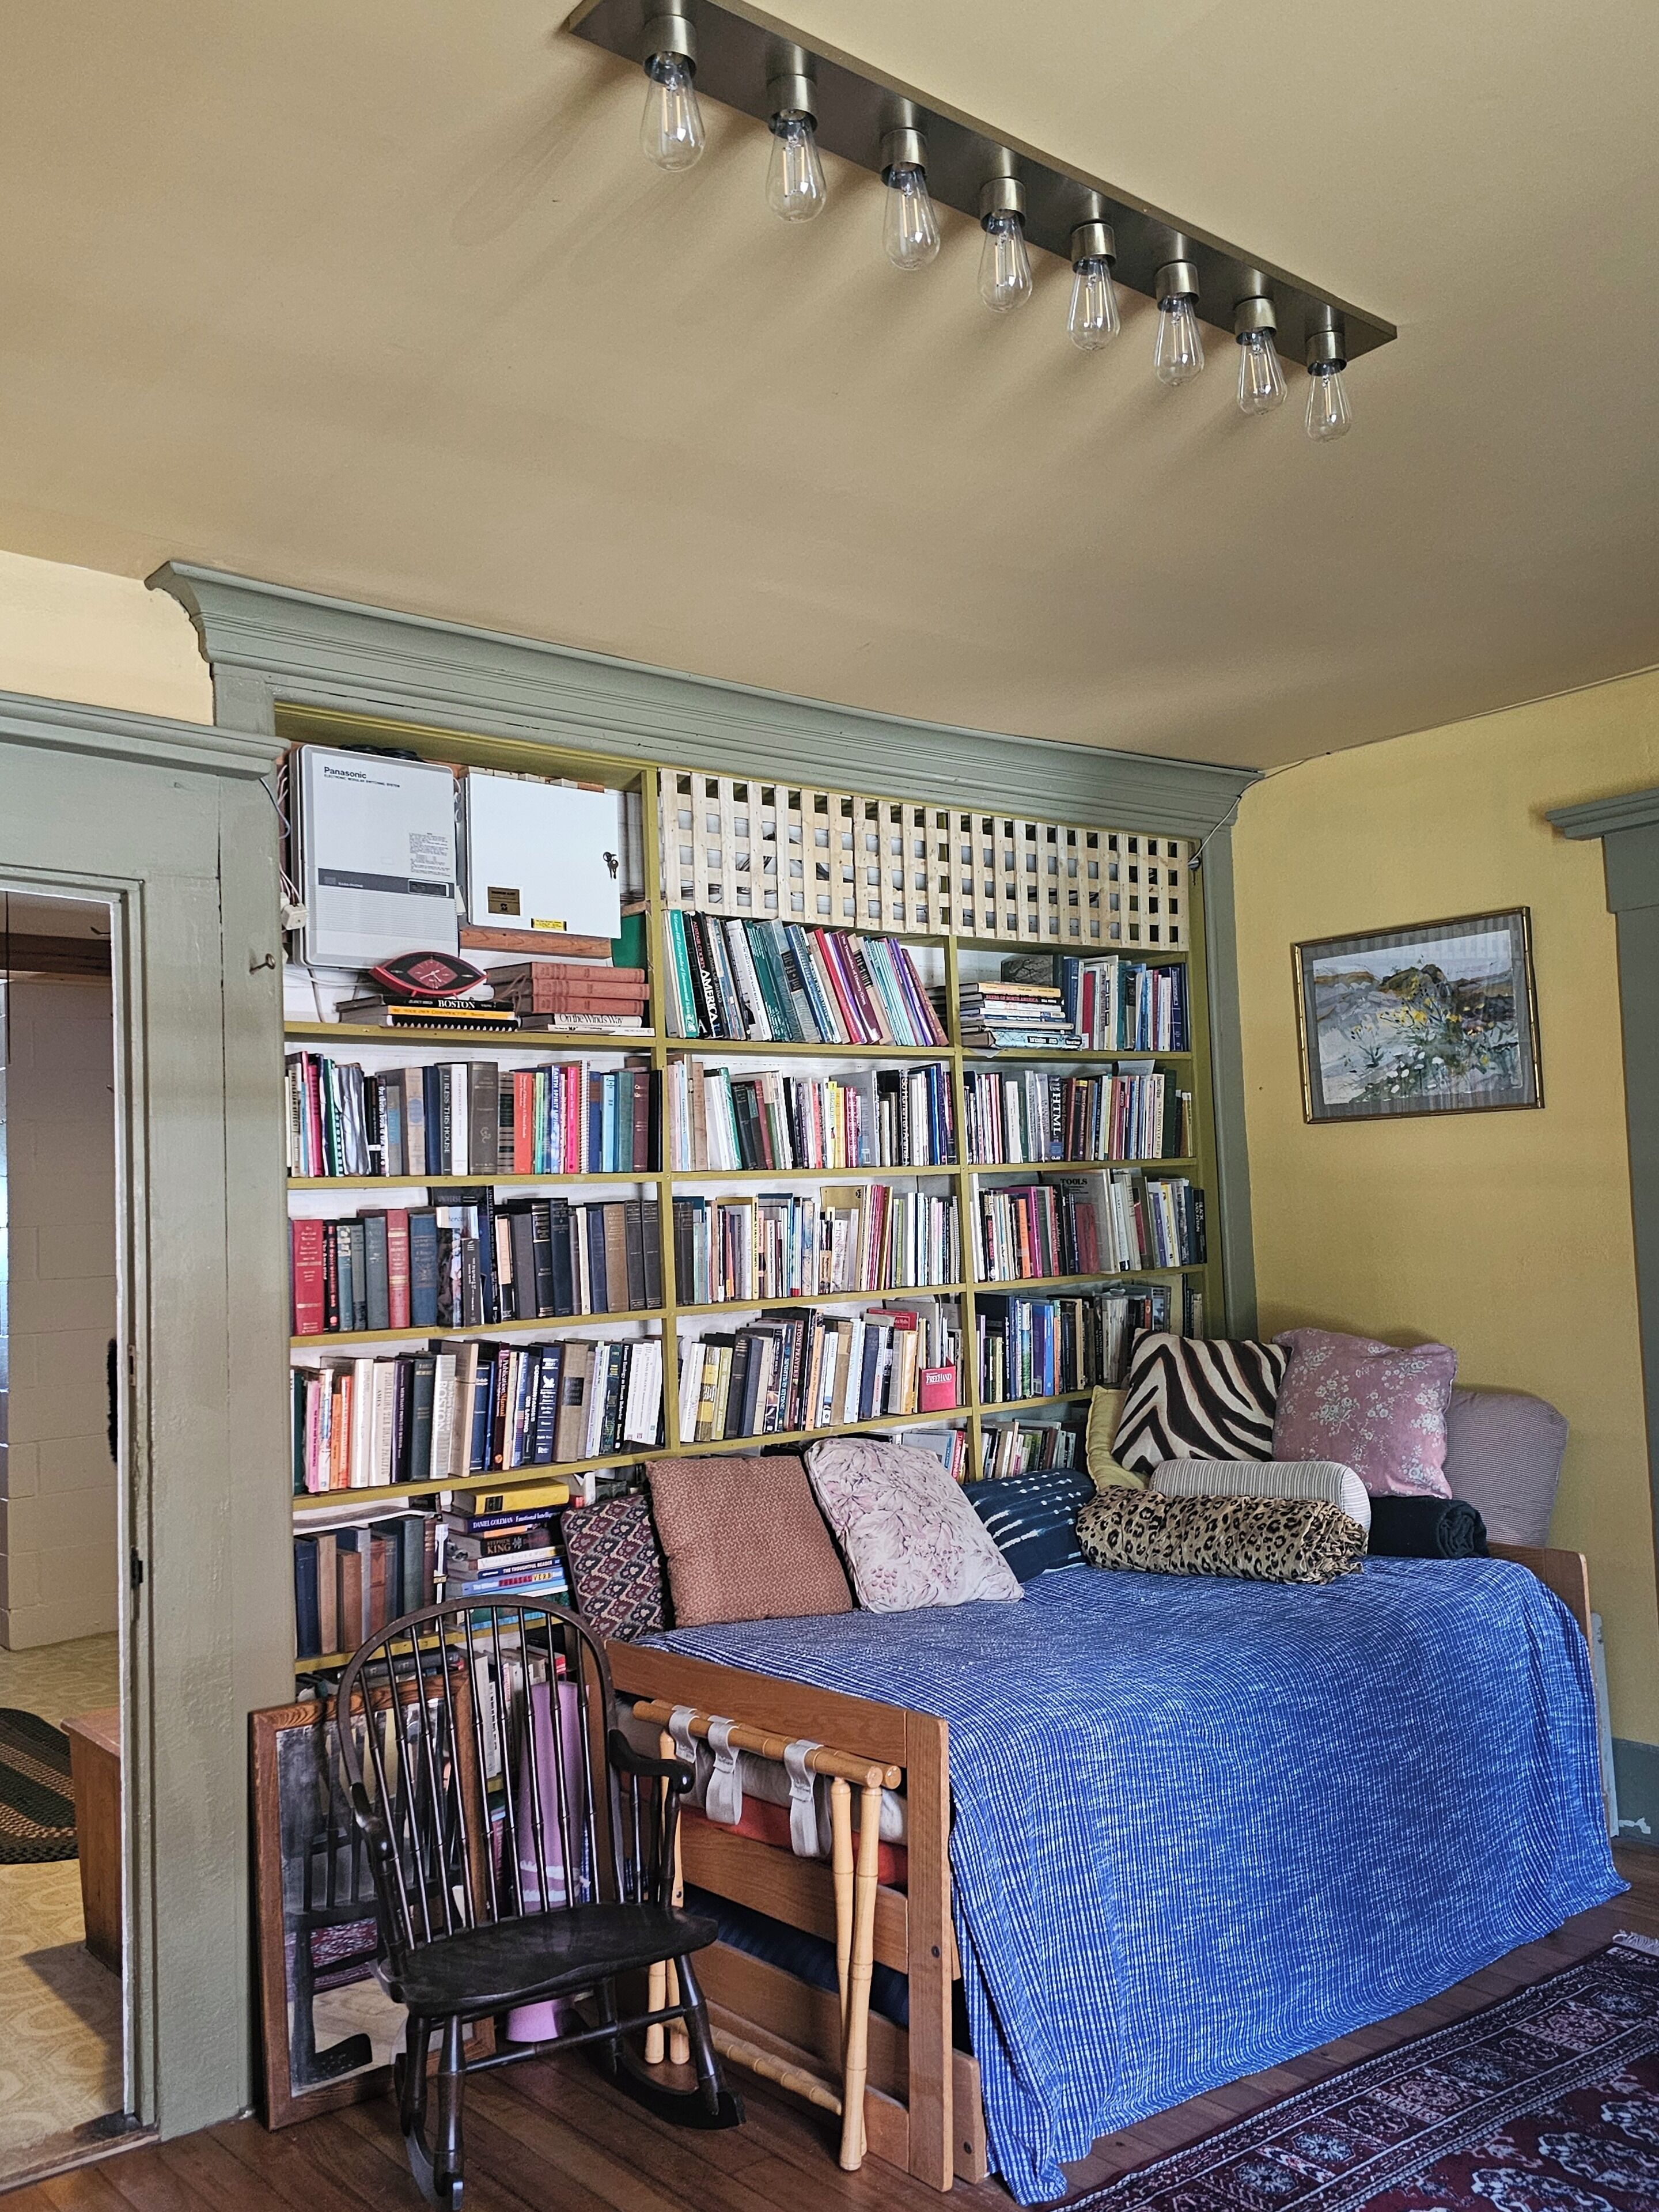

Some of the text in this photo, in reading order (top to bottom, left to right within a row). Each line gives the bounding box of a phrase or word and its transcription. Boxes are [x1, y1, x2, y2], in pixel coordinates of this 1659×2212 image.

[323, 766, 366, 779] Panasonic
[438, 999, 475, 1008] BOSTON
[700, 968, 718, 1021] AMERICA
[559, 1013, 573, 1022] On
[573, 1014, 582, 1023] the
[901, 1078, 908, 1090] So
[1052, 1092, 1060, 1135] HTML
[1060, 1177, 1087, 1185] TOOLS
[792, 1348, 800, 1377] PRAYERS
[501, 1359, 509, 1393] Publication
[436, 1380, 448, 1431] BOSTON
[778, 1388, 786, 1410] STONE
[381, 1449, 389, 1475] PACIFIC
[472, 1513, 536, 1528] DANIEL GOLEMAN Emotional
[487, 1544, 510, 1554] KING
